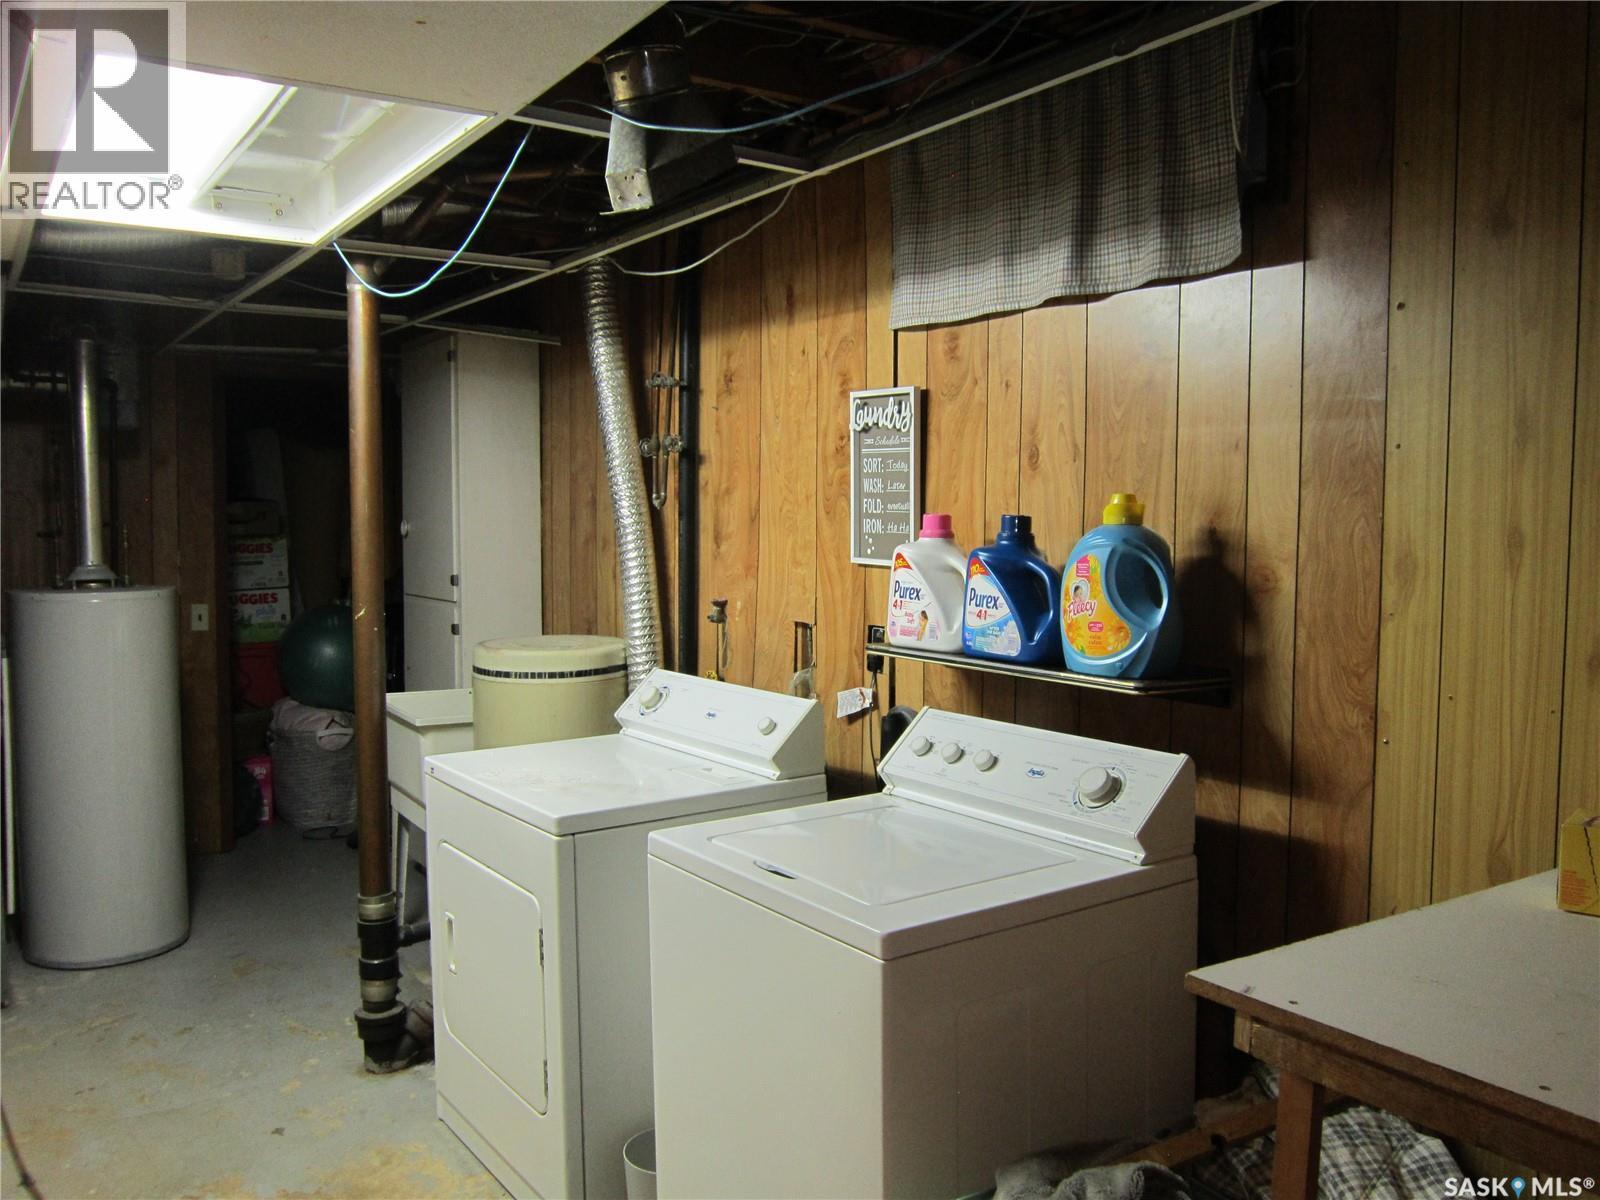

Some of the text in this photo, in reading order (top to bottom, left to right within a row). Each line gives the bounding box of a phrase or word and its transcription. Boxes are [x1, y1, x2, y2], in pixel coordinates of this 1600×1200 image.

[850, 397, 912, 432] Laundry
[863, 458, 908, 473] SORT: Today
[863, 478, 906, 493] WASH: Later
[863, 499, 884, 514] FOLD:
[863, 518, 884, 534] IRON:
[887, 521, 898, 532] Ha
[893, 580, 922, 601] Purex
[969, 587, 999, 609] Purex
[1067, 599, 1097, 619] Fleecy
